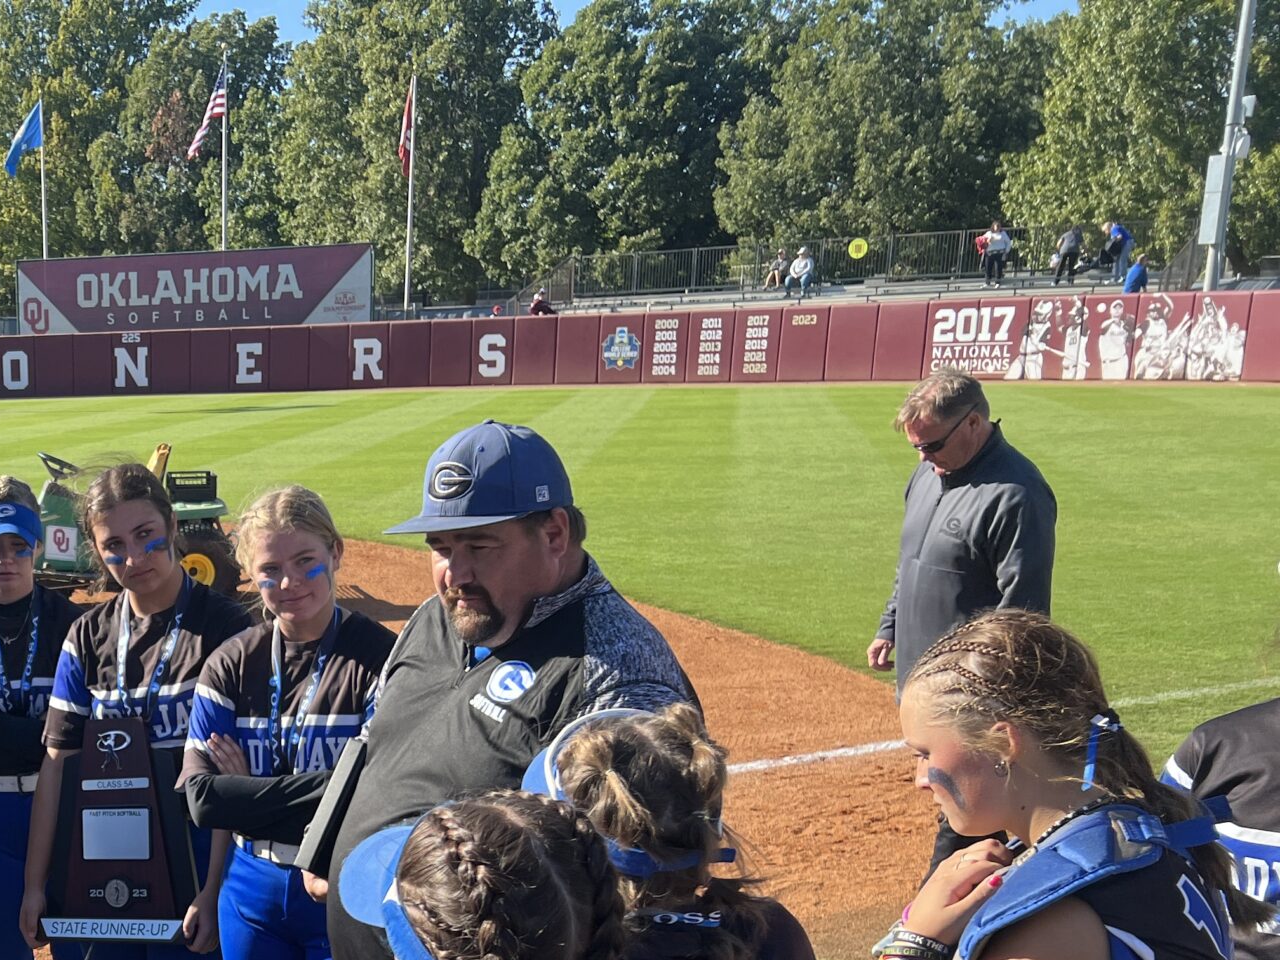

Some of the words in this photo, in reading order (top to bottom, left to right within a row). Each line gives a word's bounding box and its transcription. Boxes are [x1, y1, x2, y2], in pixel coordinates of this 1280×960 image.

[76, 264, 303, 308] OKLAHOMA
[24, 298, 50, 335] OU
[107, 306, 272, 325] SOFTBALL
[747, 315, 769, 326] 2017
[792, 314, 817, 325] 2023
[655, 319, 679, 329] 2000
[702, 318, 722, 328] 2011
[932, 306, 1016, 342] 2017
[121, 333, 141, 343] 225
[655, 331, 677, 341] 2001
[700, 330, 722, 340] 2012
[746, 327, 768, 338] 2018
[653, 342, 677, 352] 2002
[699, 341, 721, 352] 2013
[745, 339, 767, 350] 2019
[744, 351, 766, 362] 2021
[931, 345, 1012, 359] NATIONAL
[652, 353, 676, 364] 2003
[698, 353, 720, 364] 2014
[652, 365, 675, 375] 2004
[697, 365, 719, 375] 2016
[743, 363, 767, 373] 2022
[930, 357, 1011, 372] CHAMPIONS
[53, 528, 70, 553] OU
[97, 781, 121, 789] CLASS
[89, 889, 104, 897] 20
[133, 889, 147, 897] 23
[51, 922, 88, 935] STATE
[91, 923, 169, 936] RUNNER-UP
